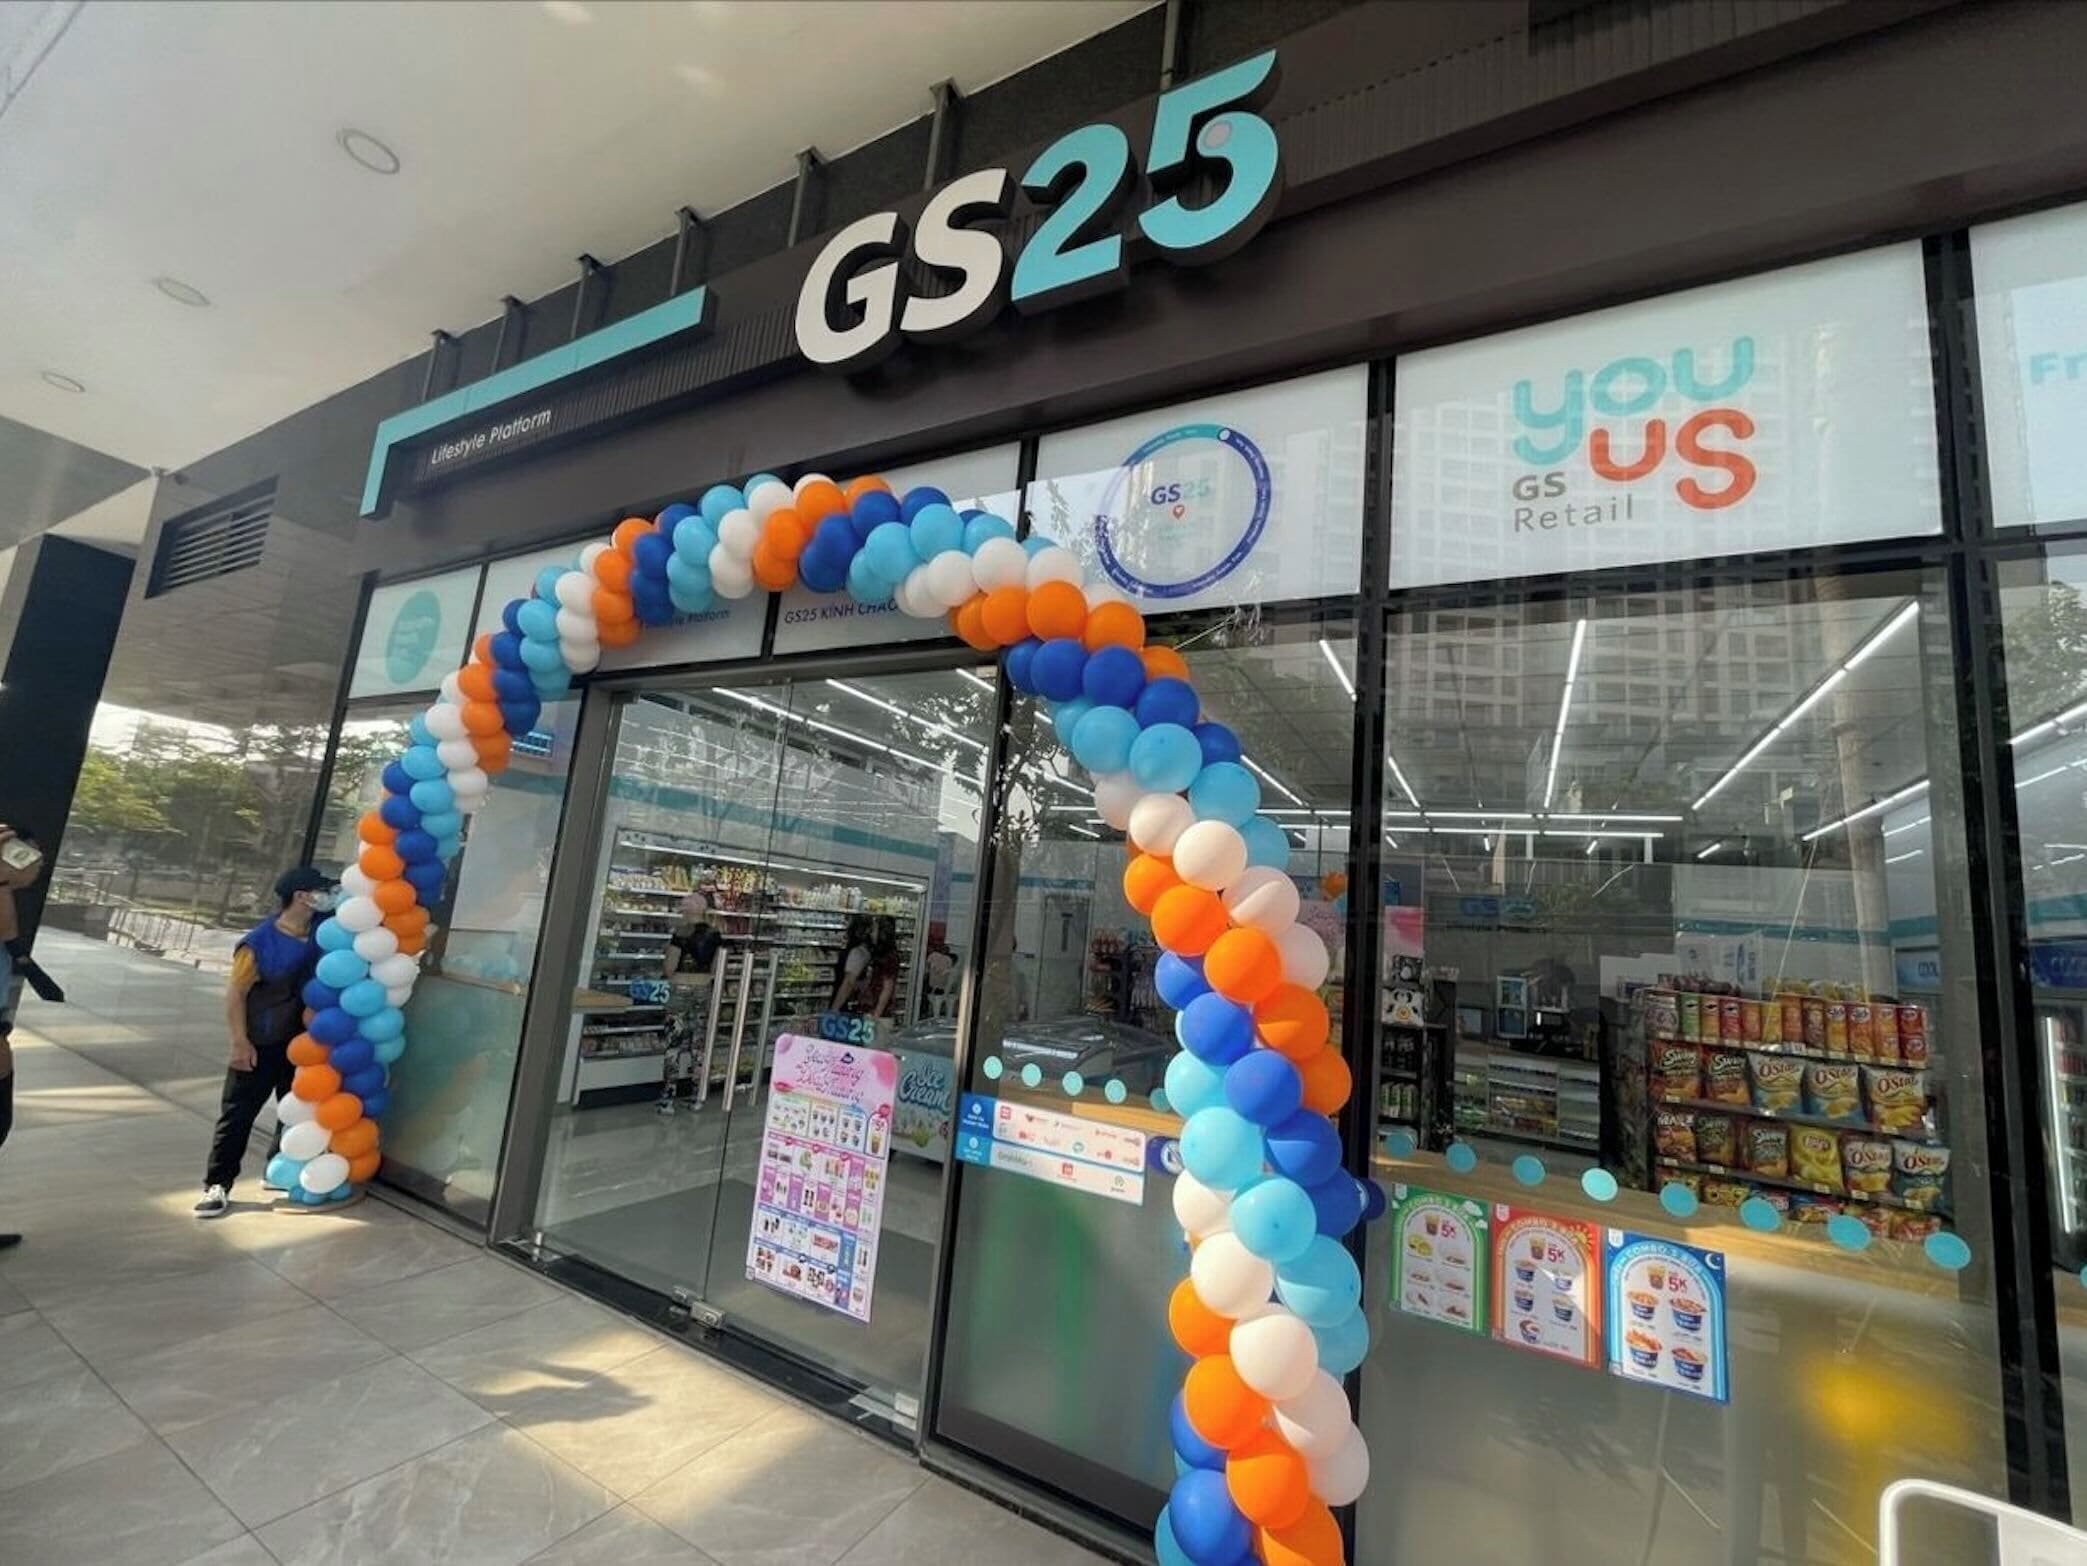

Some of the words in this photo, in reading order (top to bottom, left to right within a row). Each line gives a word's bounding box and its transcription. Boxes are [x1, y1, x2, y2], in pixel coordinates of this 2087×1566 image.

[795, 49, 1279, 365] GS25
[431, 434, 486, 465] Lifestyle
[489, 409, 552, 443] Platform
[1512, 471, 1567, 502] GS
[1513, 493, 1634, 533] Retail
[784, 607, 818, 625] GS25
[822, 1012, 875, 1044] GS25
